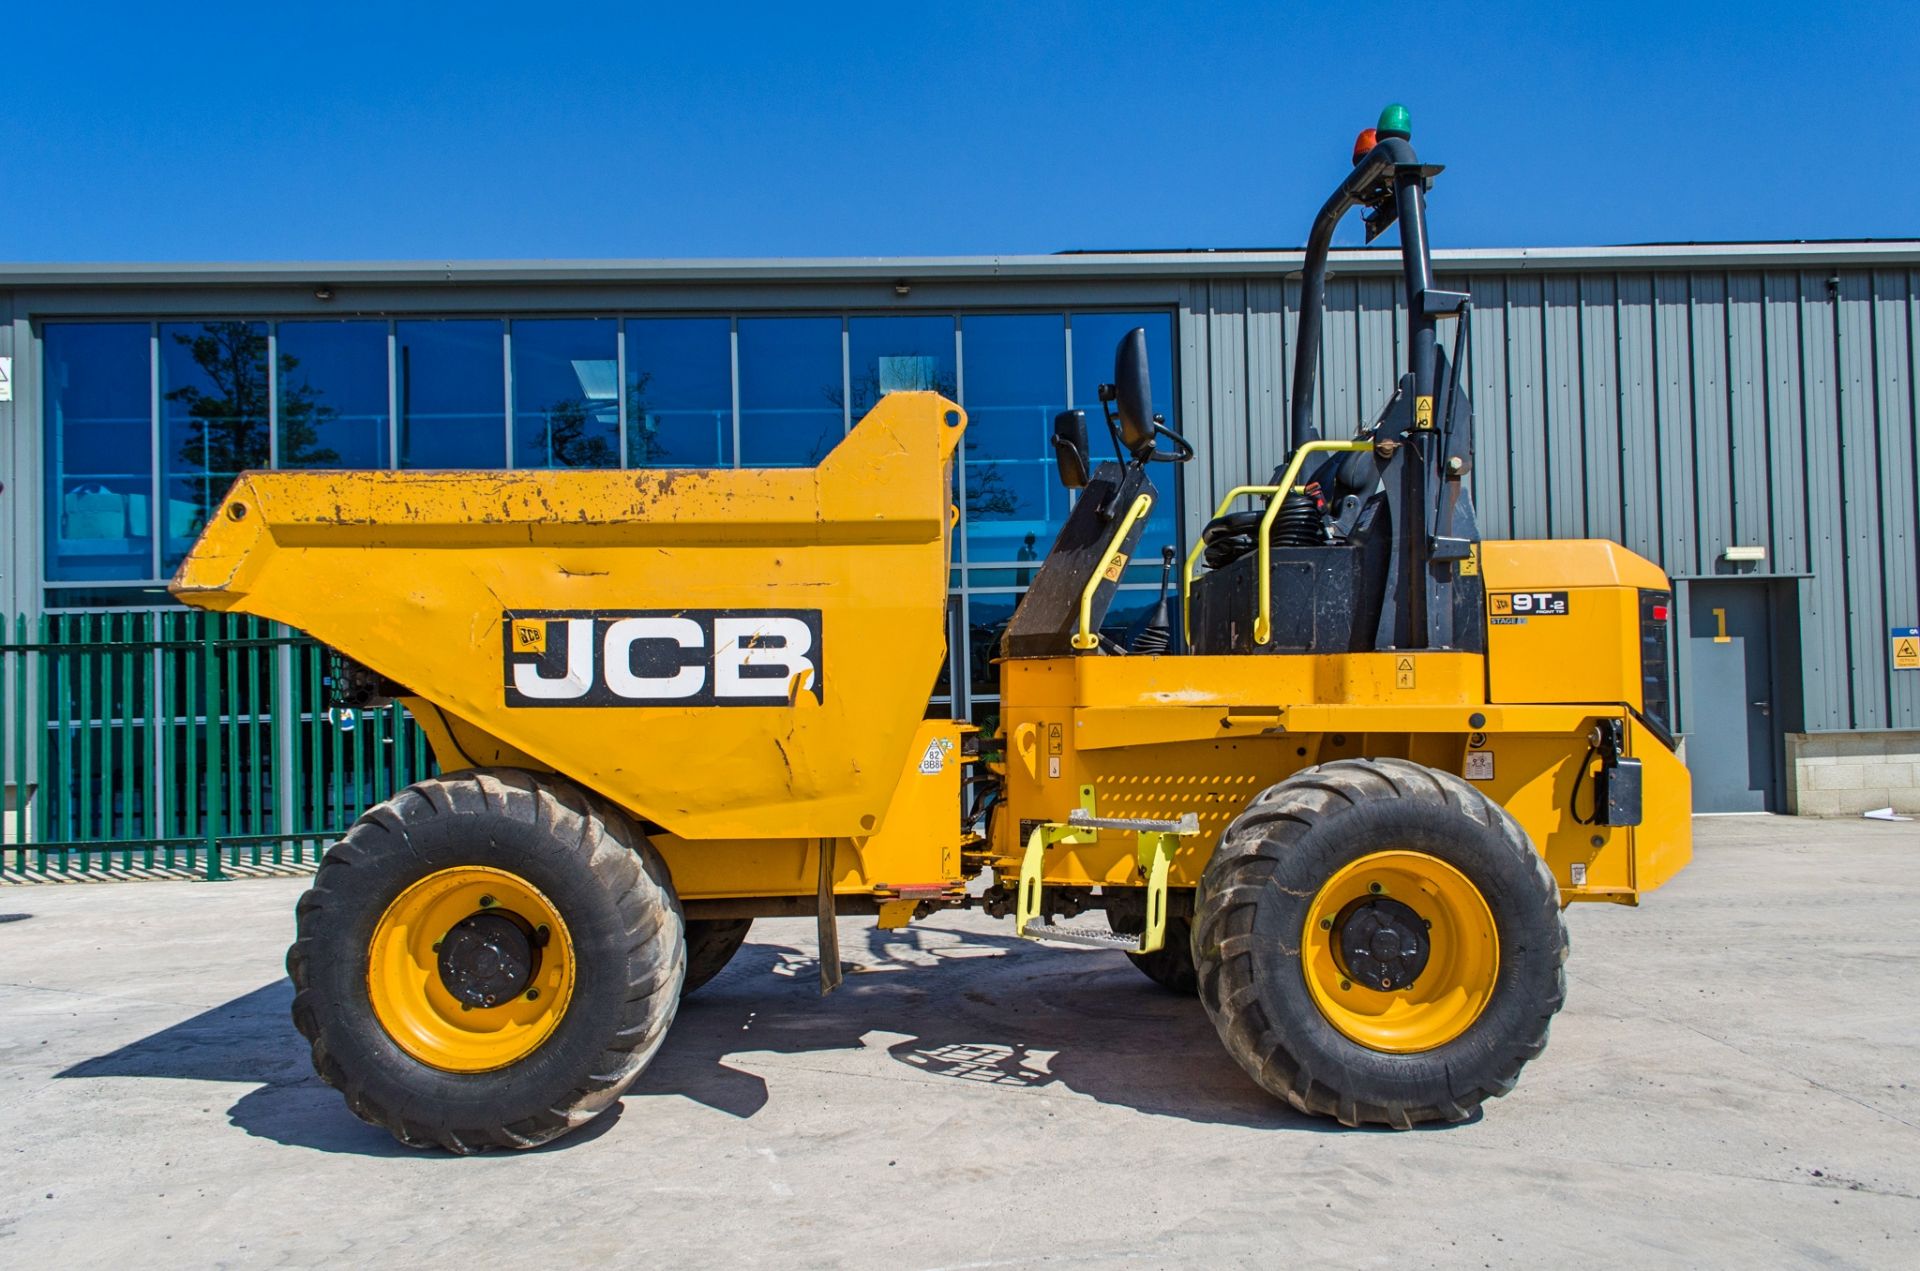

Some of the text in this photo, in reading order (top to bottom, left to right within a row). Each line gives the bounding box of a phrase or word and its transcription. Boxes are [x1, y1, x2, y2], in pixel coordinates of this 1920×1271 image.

[520, 628, 540, 643] JCB
[1712, 608, 1732, 643] 1
[513, 617, 815, 699] JCB
[929, 751, 940, 760] 82
